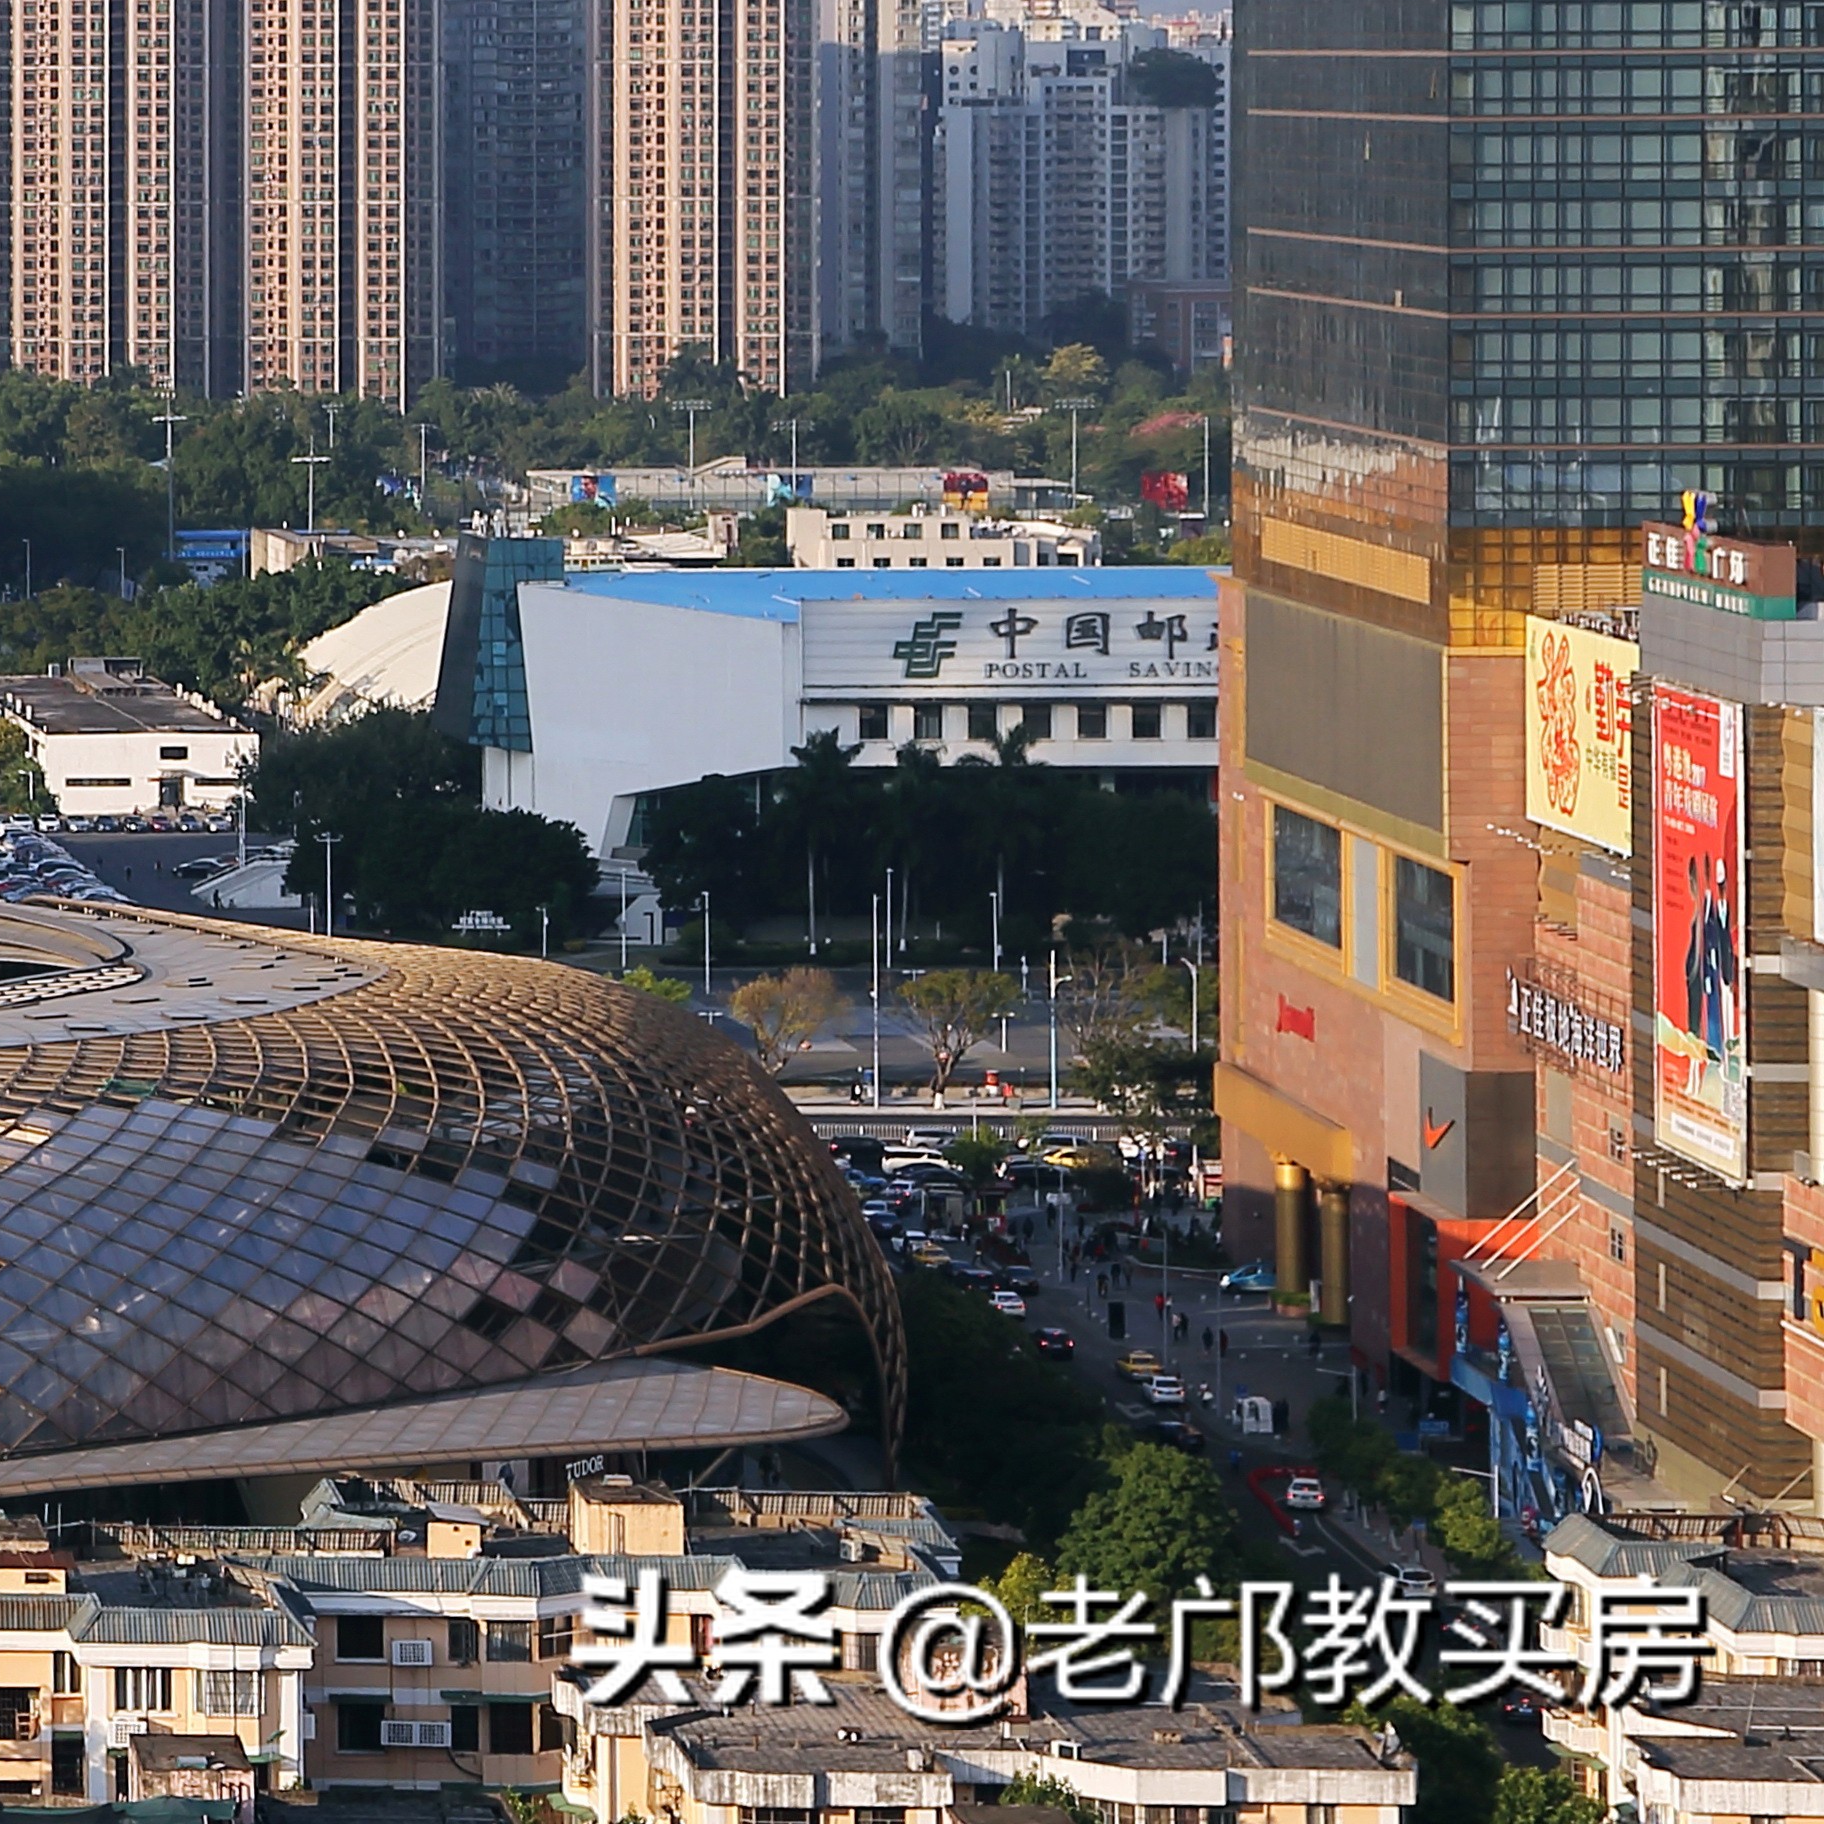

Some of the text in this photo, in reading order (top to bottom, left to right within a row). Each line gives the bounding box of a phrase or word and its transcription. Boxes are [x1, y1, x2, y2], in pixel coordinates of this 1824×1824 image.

[985, 662, 1088, 679] POSTAL
[1519, 986, 1622, 1073] 正佳极地海洋世界
[565, 1454, 605, 1482] TUDOR
